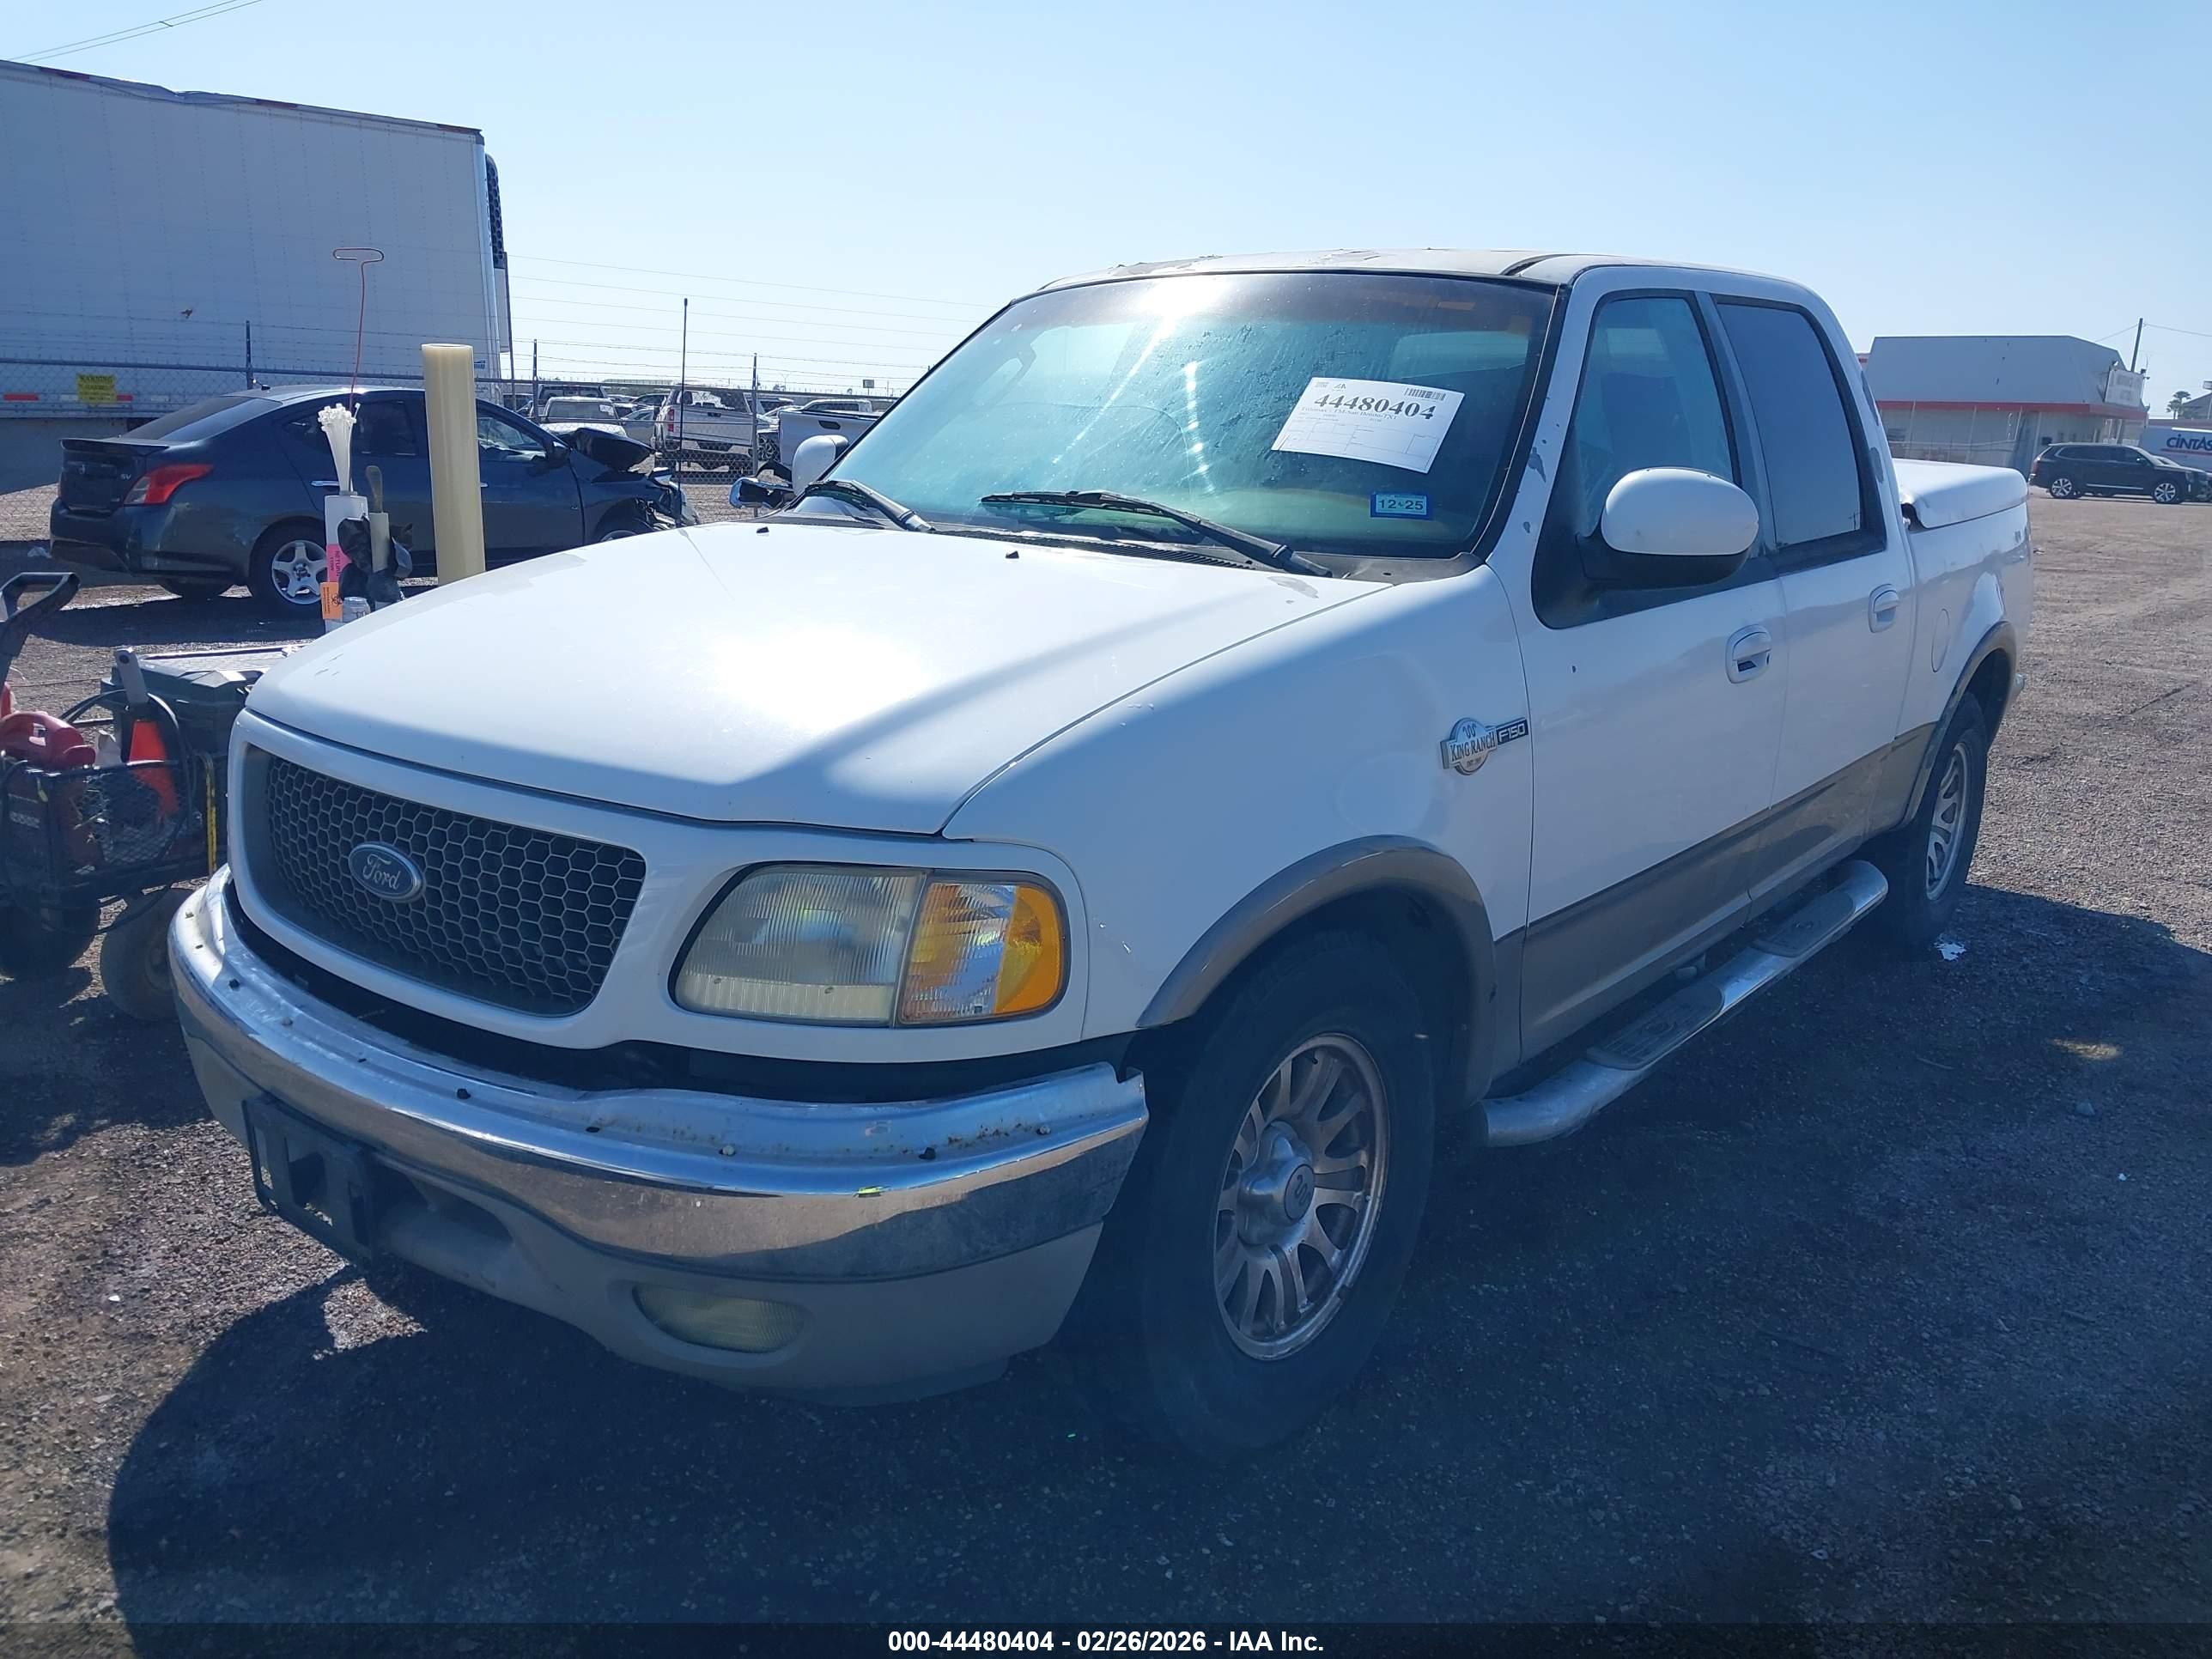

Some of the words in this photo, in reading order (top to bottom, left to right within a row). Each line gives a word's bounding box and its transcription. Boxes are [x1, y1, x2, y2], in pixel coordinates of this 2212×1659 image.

[1314, 393, 1437, 420] 44480404
[1471, 731, 1496, 755] RANCH
[1498, 723, 1526, 743] F150
[362, 853, 402, 890] Ford
